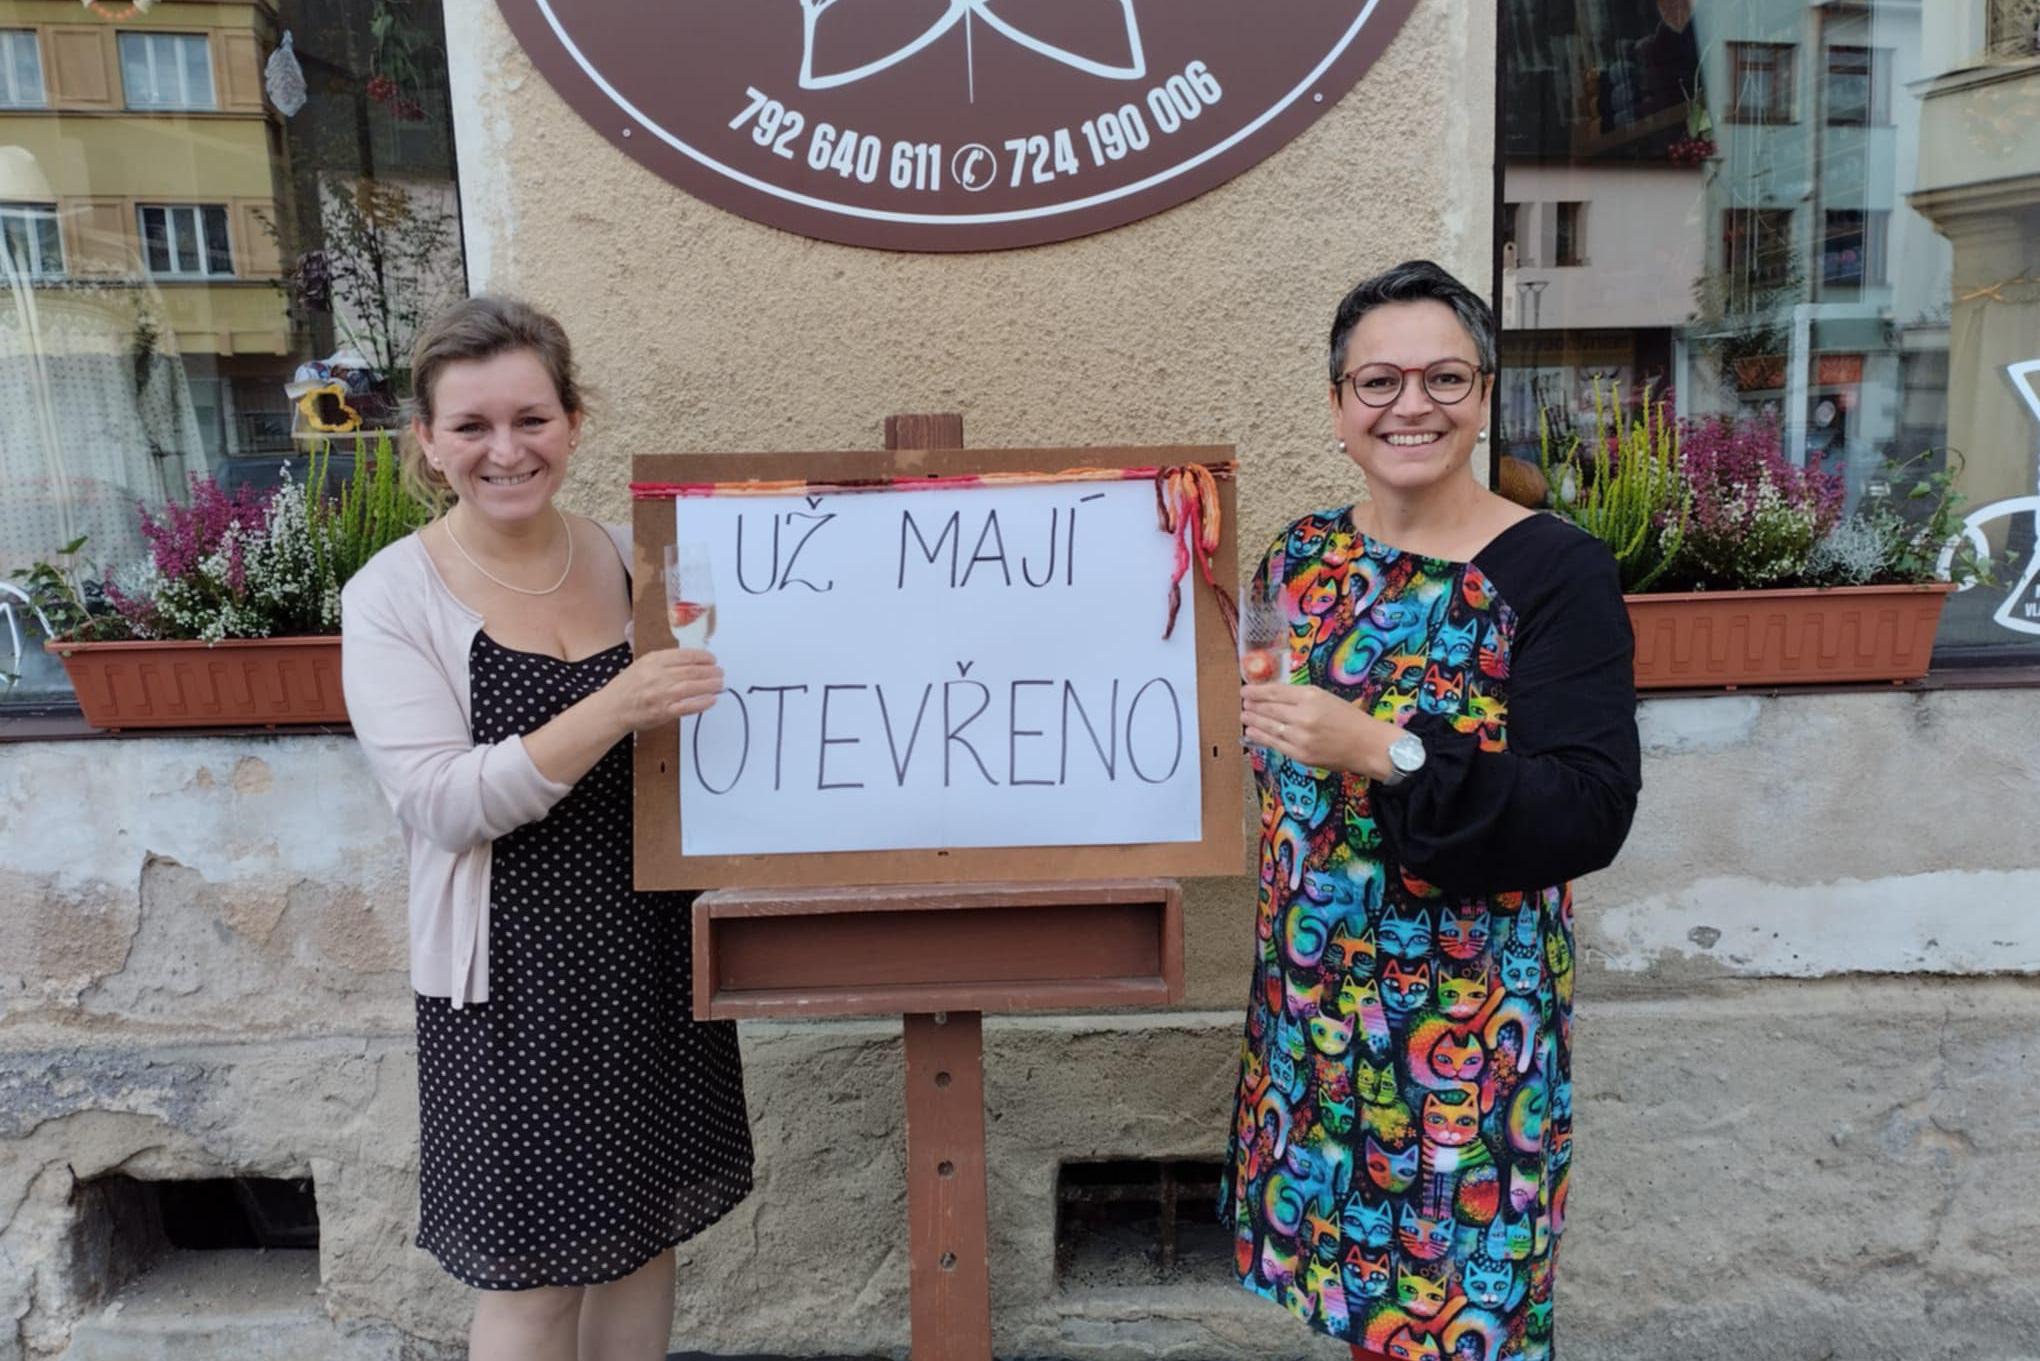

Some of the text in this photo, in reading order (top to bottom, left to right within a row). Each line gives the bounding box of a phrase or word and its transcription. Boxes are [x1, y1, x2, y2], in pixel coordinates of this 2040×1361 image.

[728, 60, 1222, 191] 792 640 611 724 190 006
[736, 493, 1106, 595] UŽ MAJÍ
[692, 660, 1183, 795] OTEVŘENO
